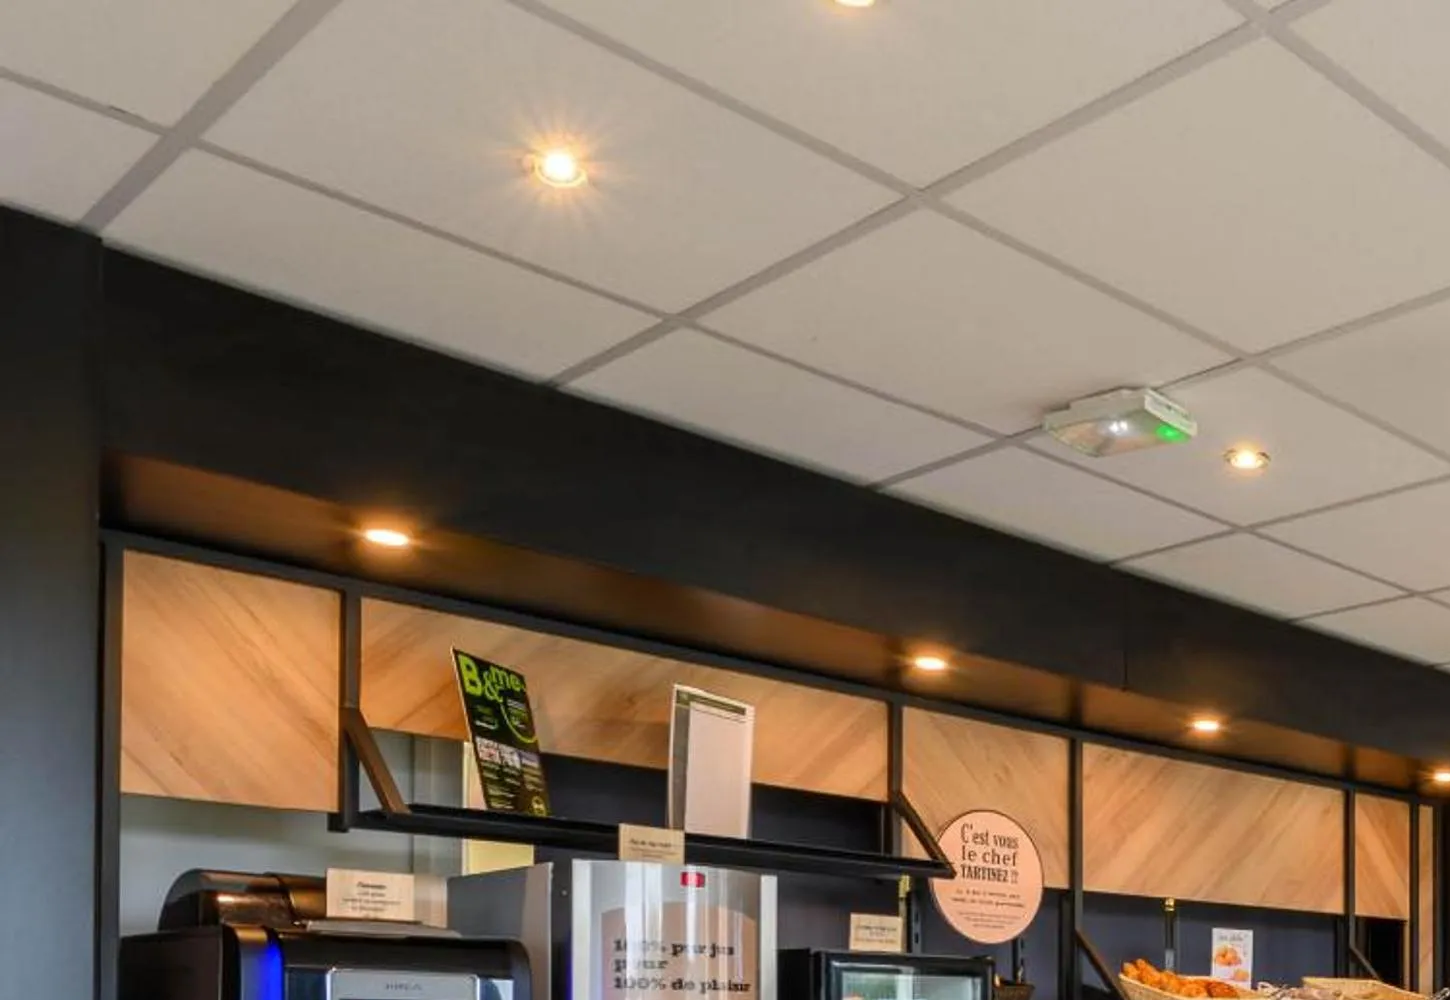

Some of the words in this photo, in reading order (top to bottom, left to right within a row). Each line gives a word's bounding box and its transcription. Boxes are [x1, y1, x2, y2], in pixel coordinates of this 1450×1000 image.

[961, 823, 989, 846] C'est
[993, 834, 1019, 849] vous
[962, 845, 977, 862] le
[982, 848, 1016, 867] chef
[614, 959, 668, 973] pur
[614, 978, 667, 990] 100%
[671, 978, 695, 991] de
